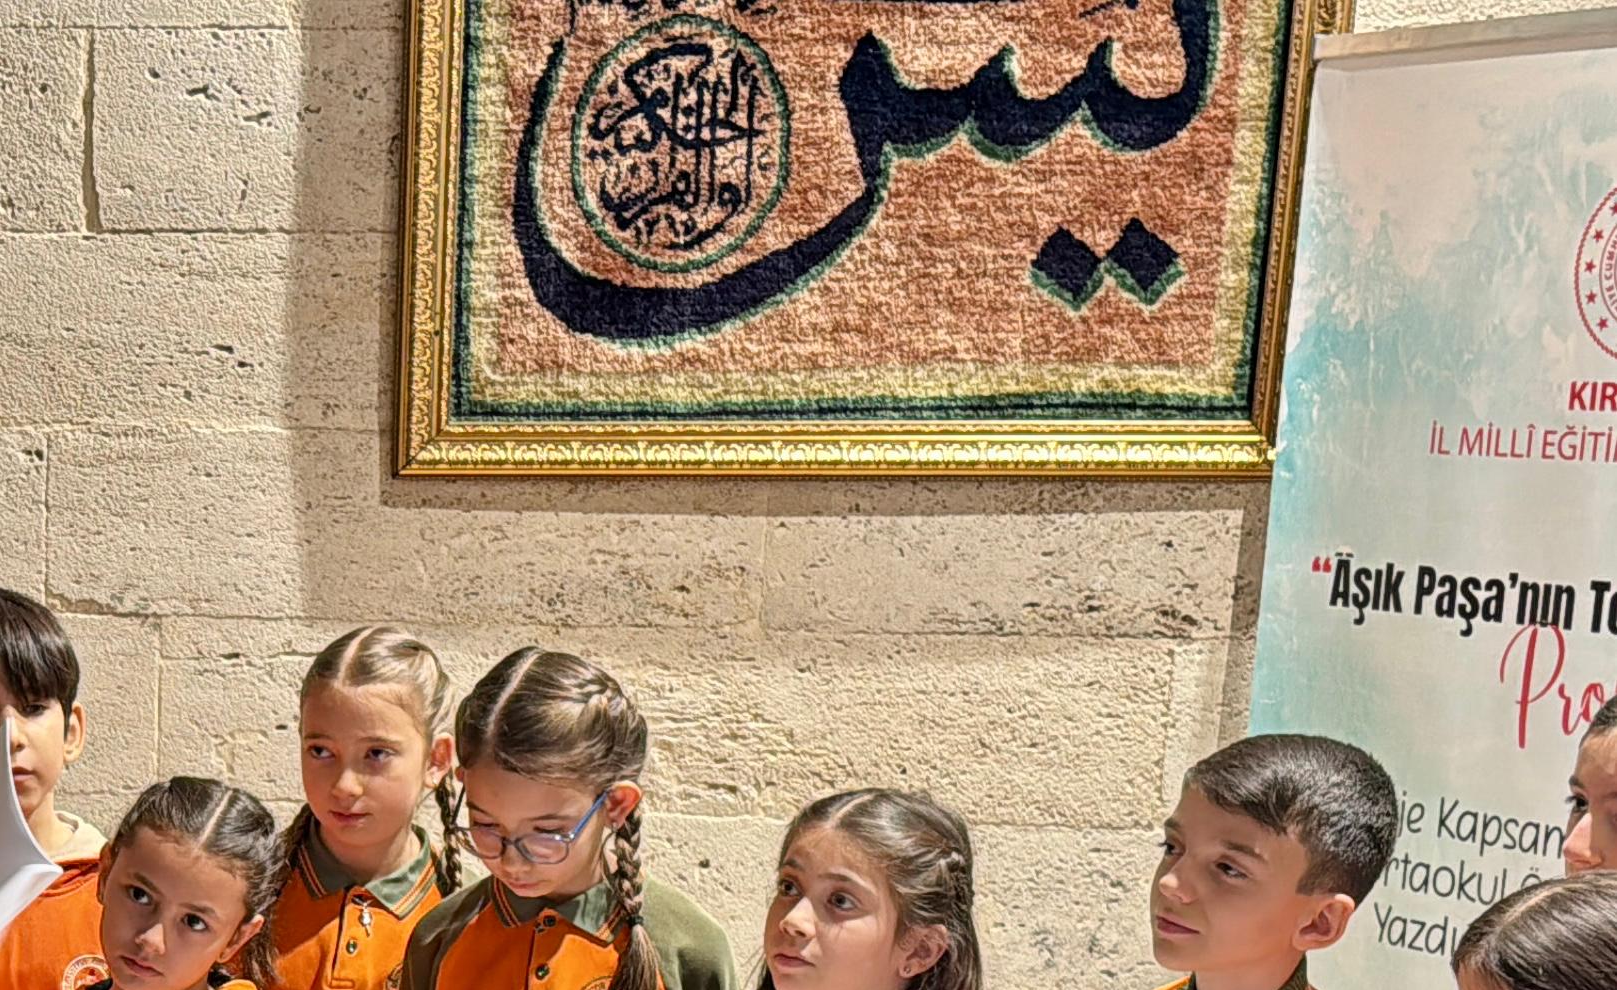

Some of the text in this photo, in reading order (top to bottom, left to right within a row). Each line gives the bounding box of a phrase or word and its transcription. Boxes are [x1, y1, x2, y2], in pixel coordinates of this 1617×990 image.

[1429, 420, 1617, 463] İL MİLLÎ EĞİTİ
[1414, 564, 1576, 638] Paşa'nın
[1499, 620, 1617, 750] Pro
[1383, 852, 1507, 906] rtaokul
